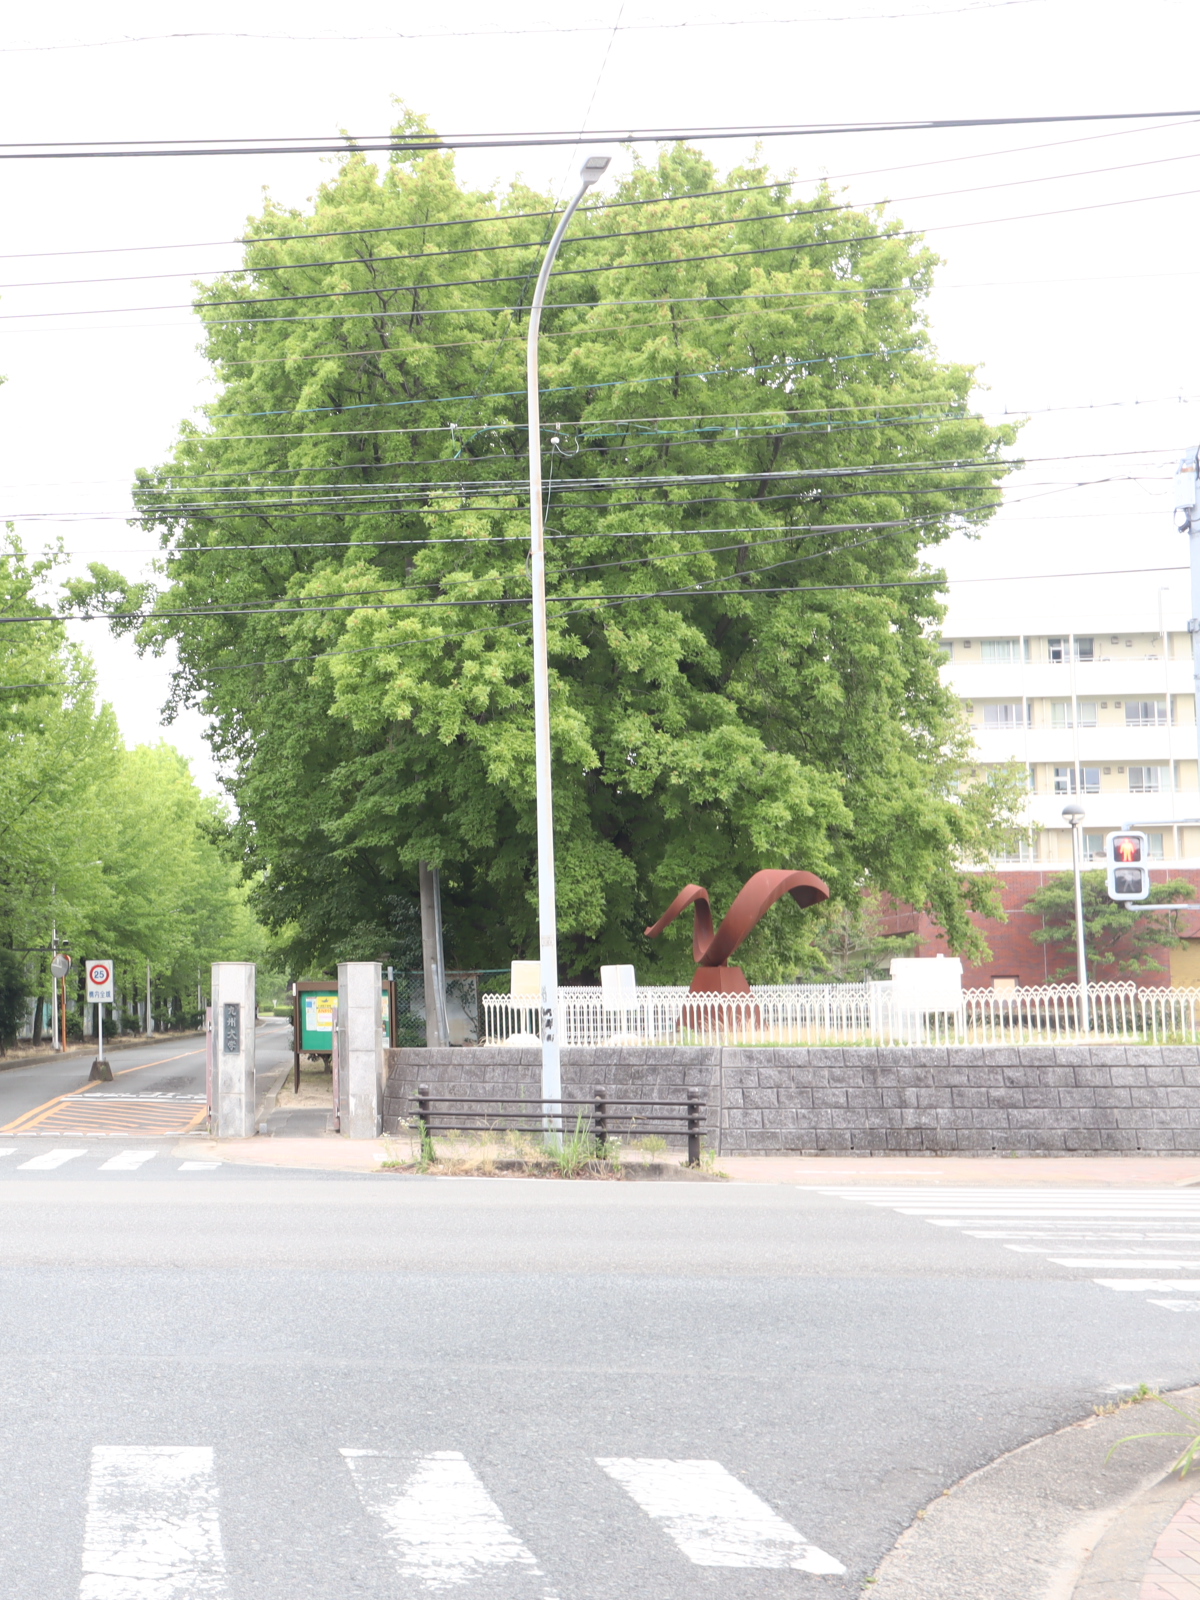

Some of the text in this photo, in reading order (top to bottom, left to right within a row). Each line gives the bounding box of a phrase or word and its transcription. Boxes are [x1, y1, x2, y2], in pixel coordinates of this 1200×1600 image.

[94, 970, 105, 979] 25
[227, 1005, 237, 1051] 九州大学
